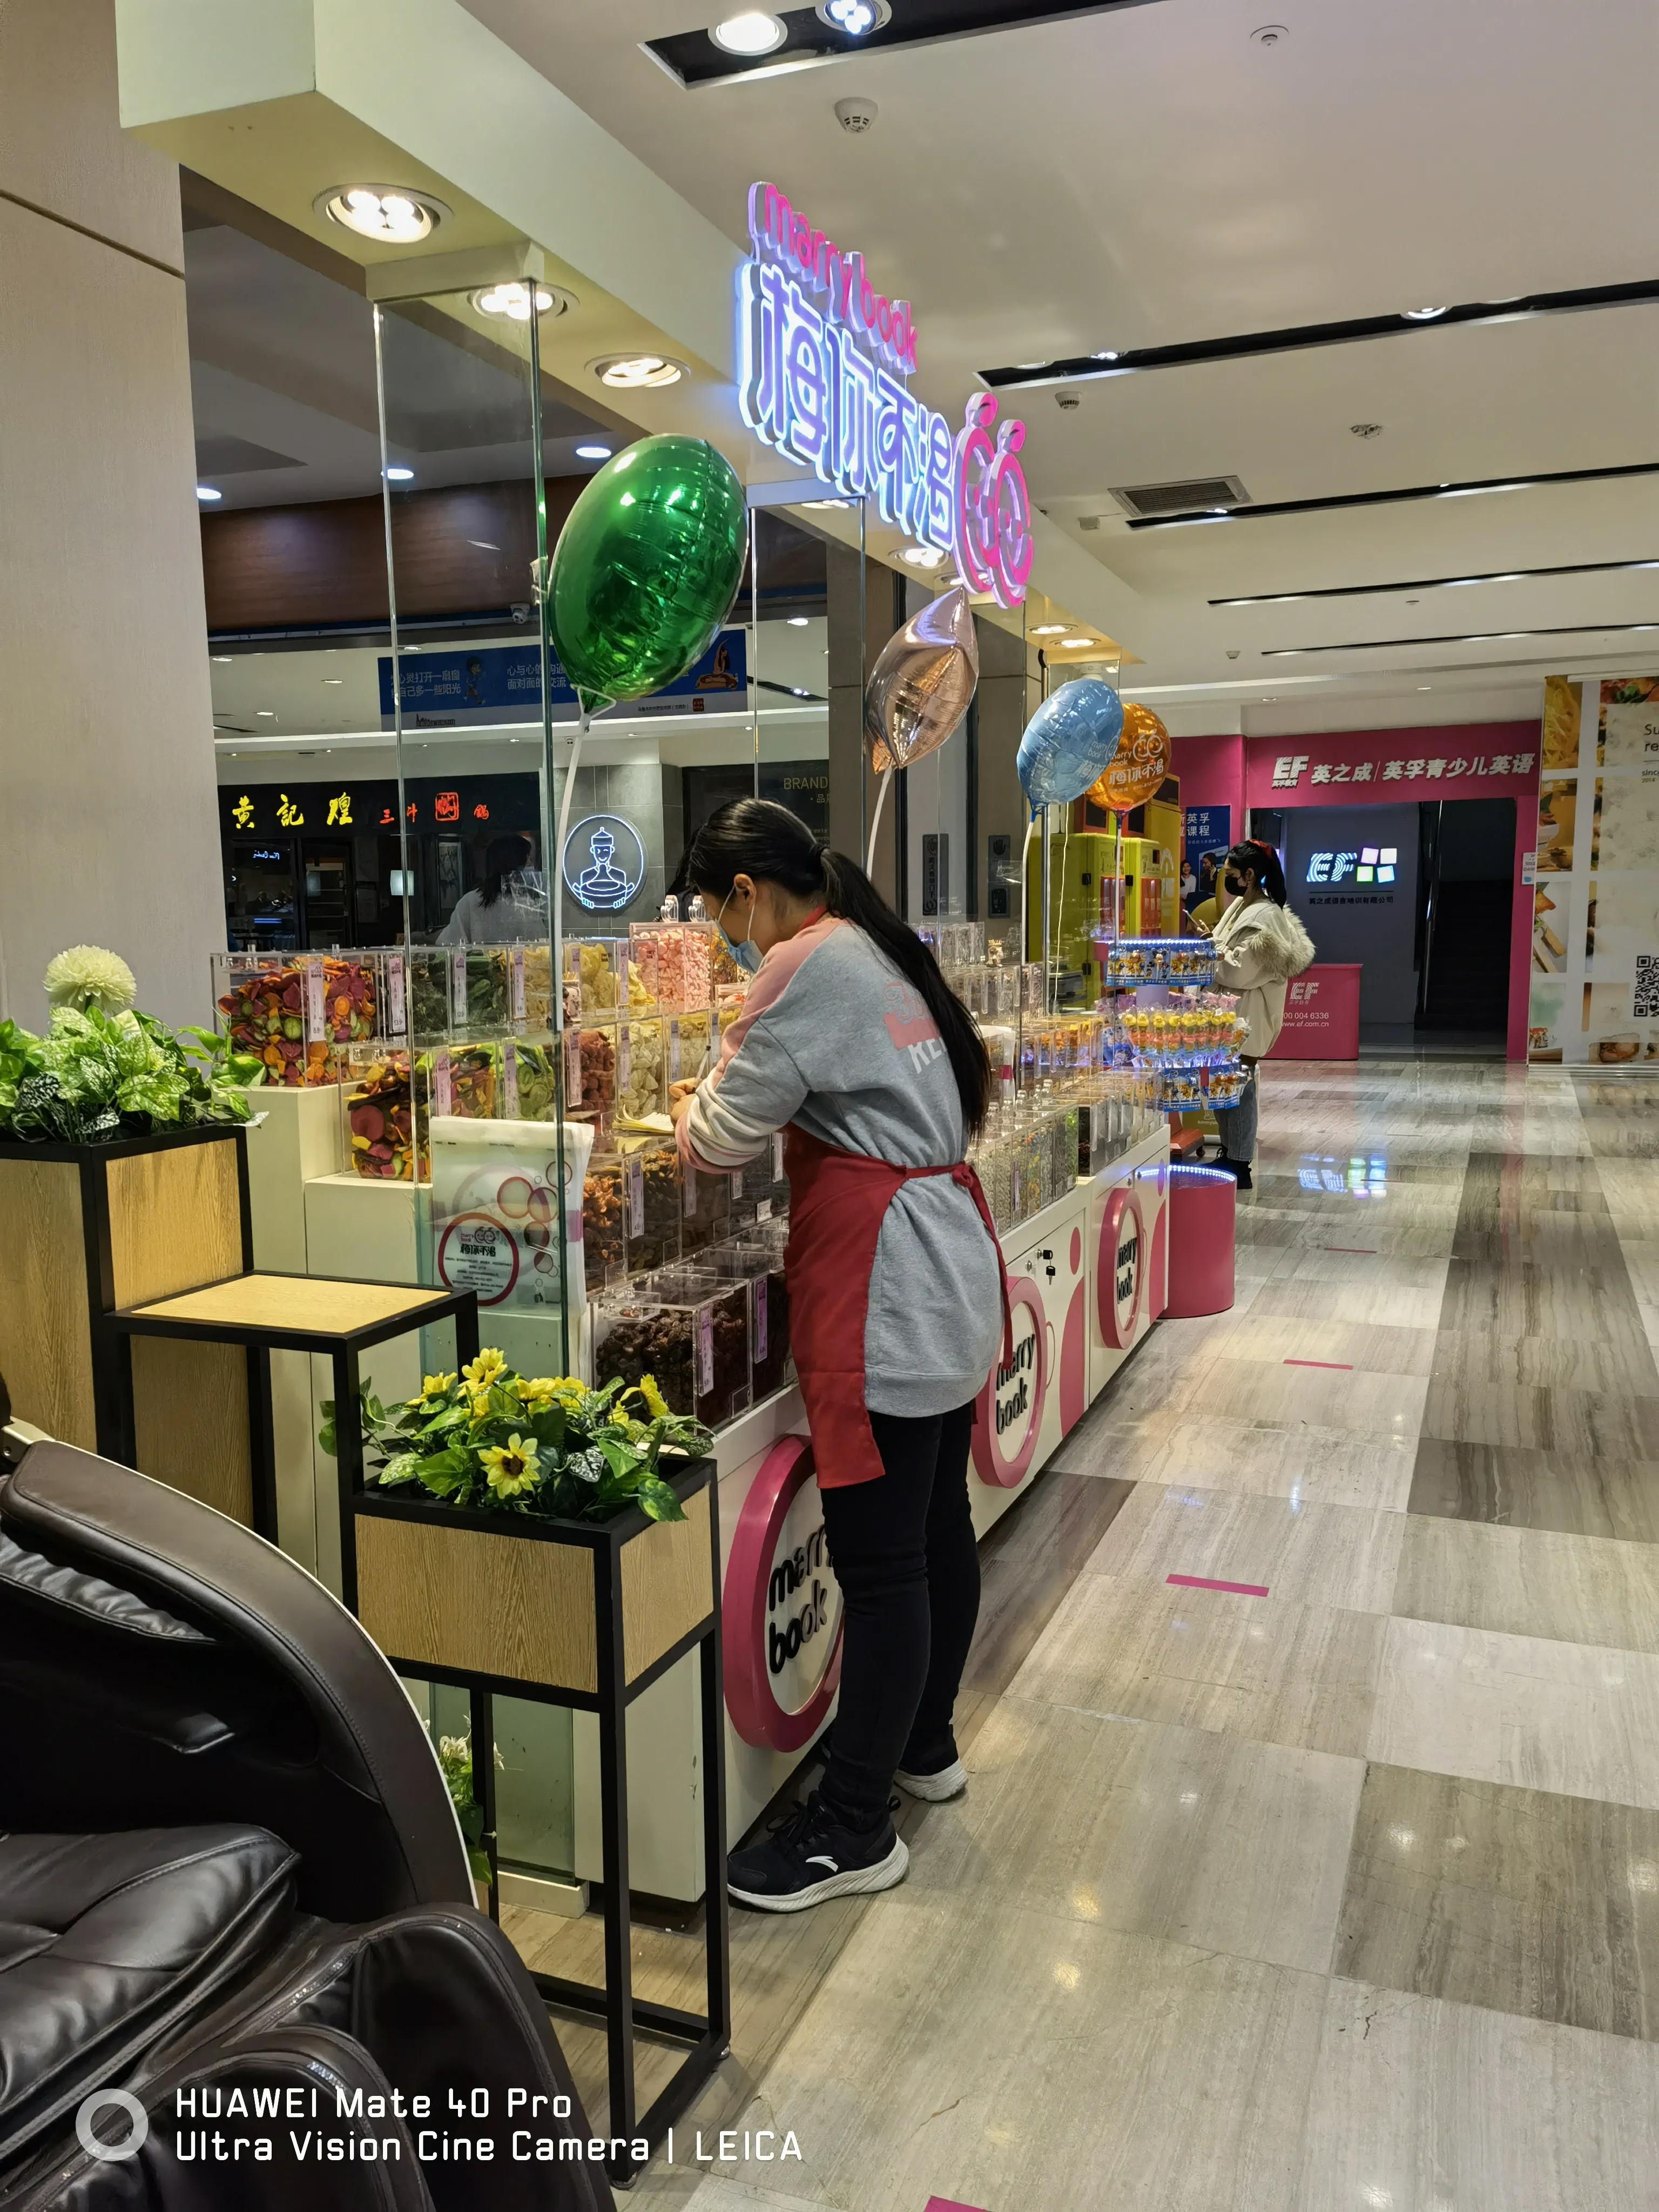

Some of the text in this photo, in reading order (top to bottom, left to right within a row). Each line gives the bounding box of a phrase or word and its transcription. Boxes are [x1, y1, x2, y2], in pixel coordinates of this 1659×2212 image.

[850, 252, 919, 373] book
[1273, 756, 1310, 779] EF
[1306, 852, 1358, 882] EF
[1289, 982, 1320, 1000] EF
[1116, 1267, 1132, 1305] book
[996, 1377, 1028, 1435] book
[769, 1524, 834, 1612] marr
[769, 1579, 828, 1674] book
